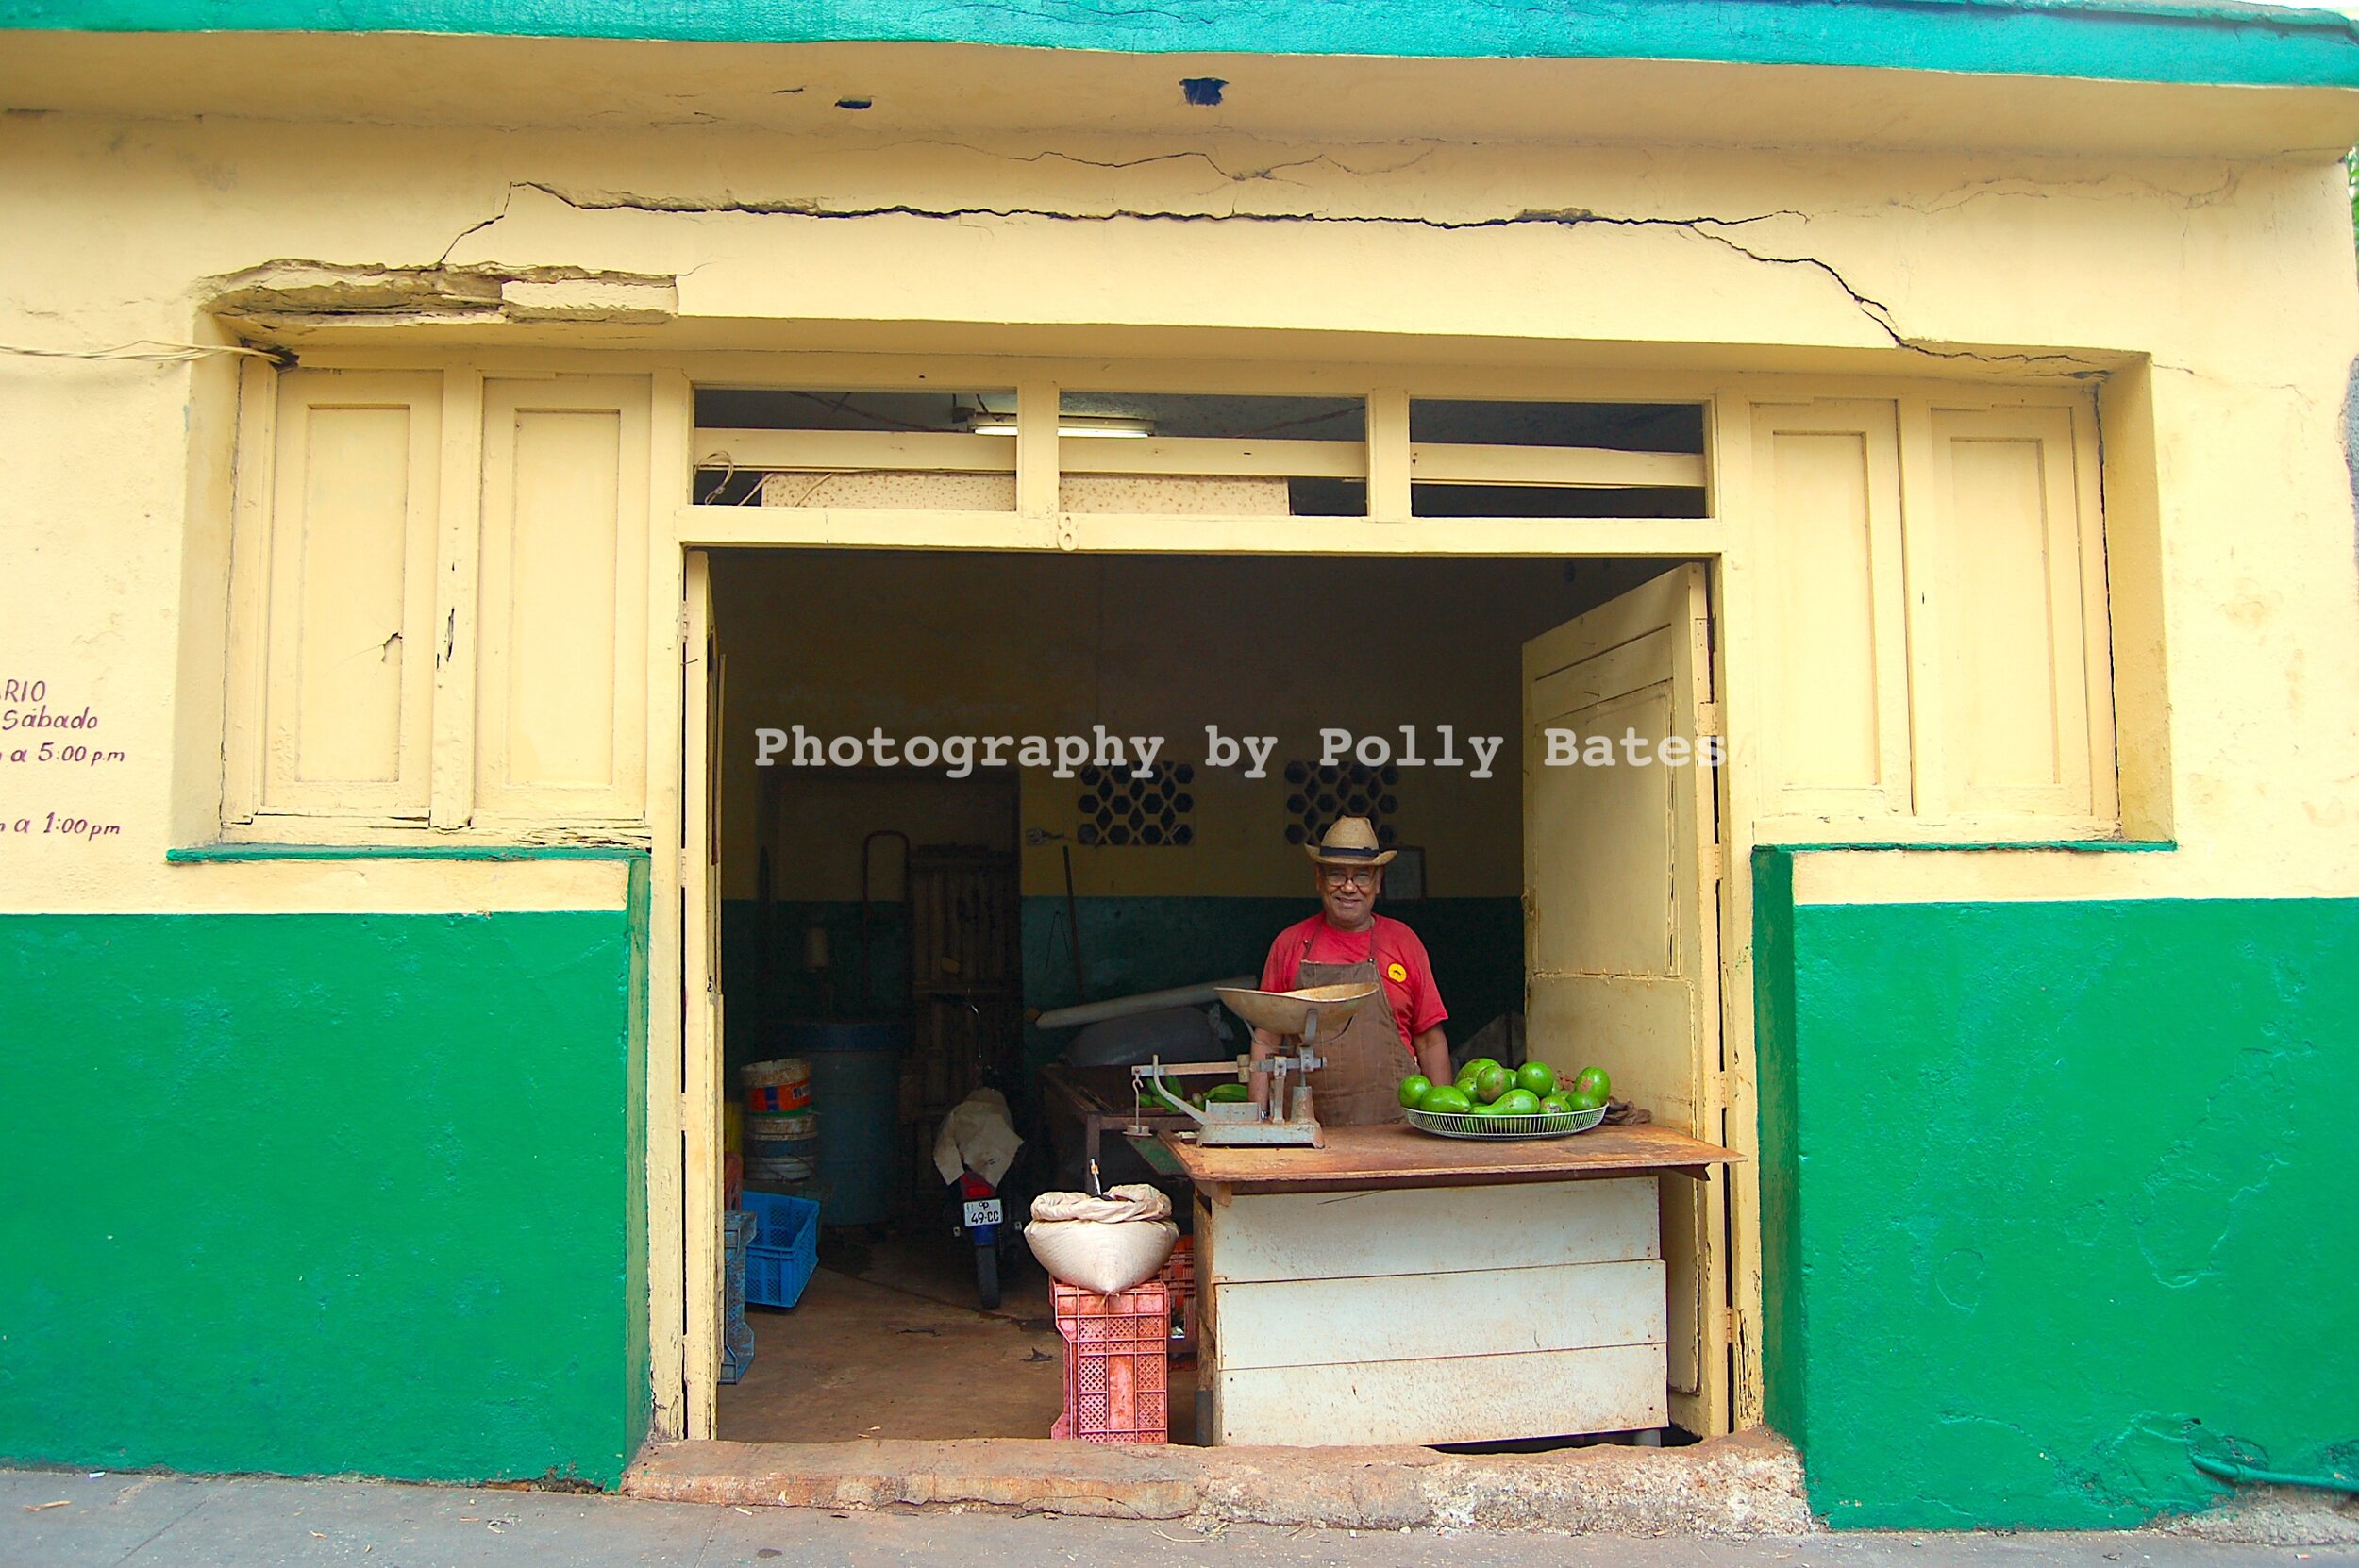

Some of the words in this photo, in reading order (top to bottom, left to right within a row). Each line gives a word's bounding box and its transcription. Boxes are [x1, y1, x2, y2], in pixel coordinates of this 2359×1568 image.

[0, 678, 46, 703] RIO
[10, 749, 27, 763] a
[14, 818, 31, 834] a
